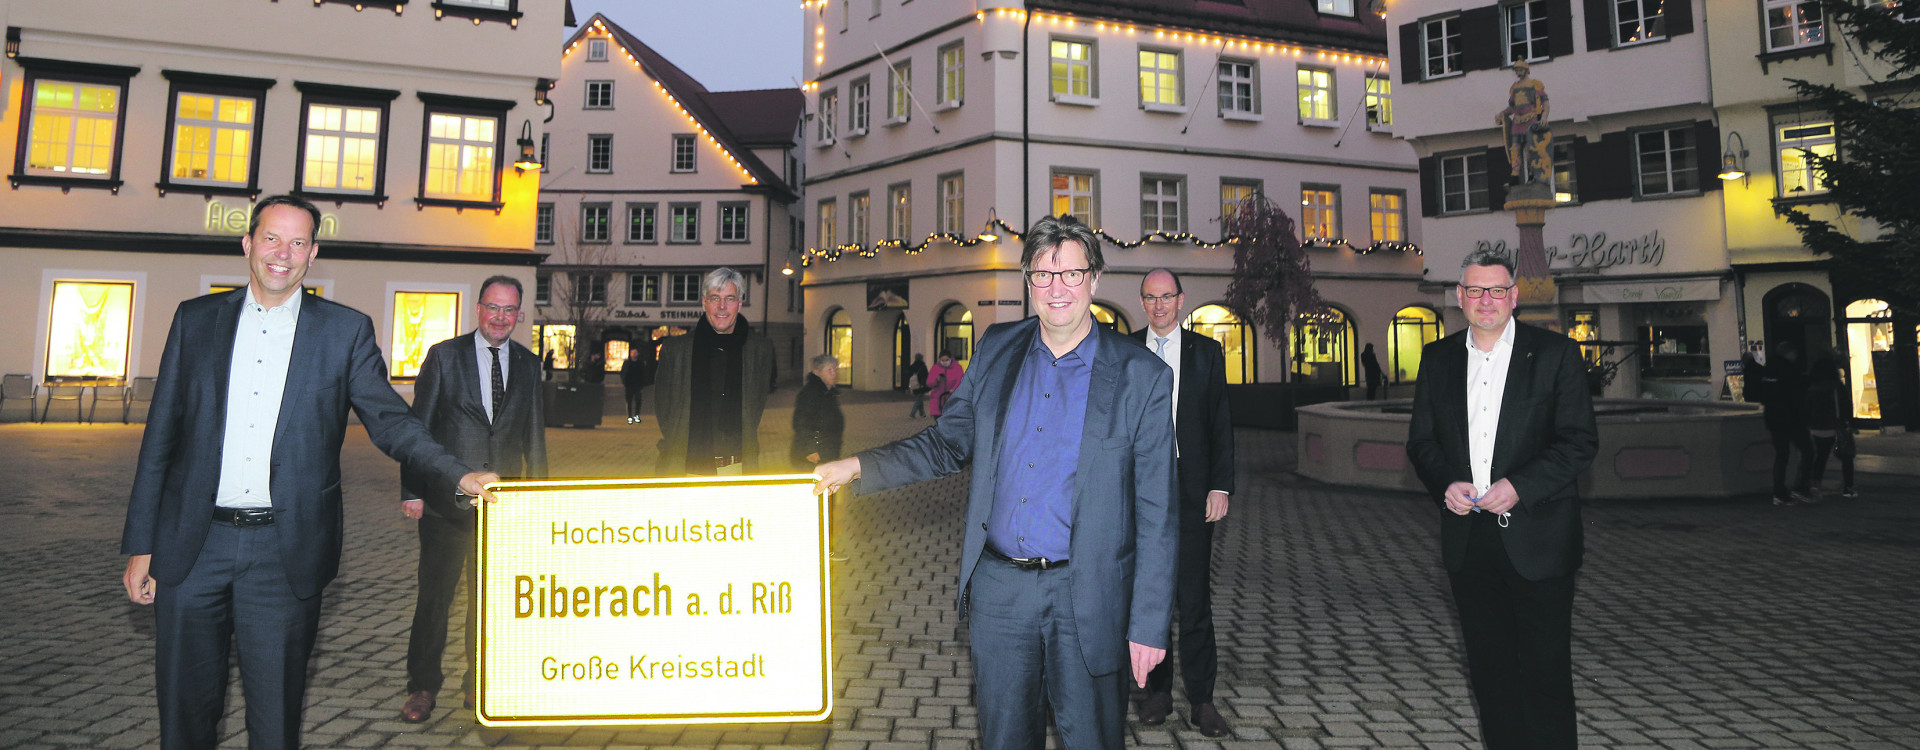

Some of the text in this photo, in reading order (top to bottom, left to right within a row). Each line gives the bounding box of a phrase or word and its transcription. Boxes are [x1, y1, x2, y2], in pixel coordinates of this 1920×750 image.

[551, 517, 754, 545] Hochschulstadt
[514, 572, 792, 619] Biberach a. d. Riß
[541, 653, 765, 681] Große Kreisstadt
